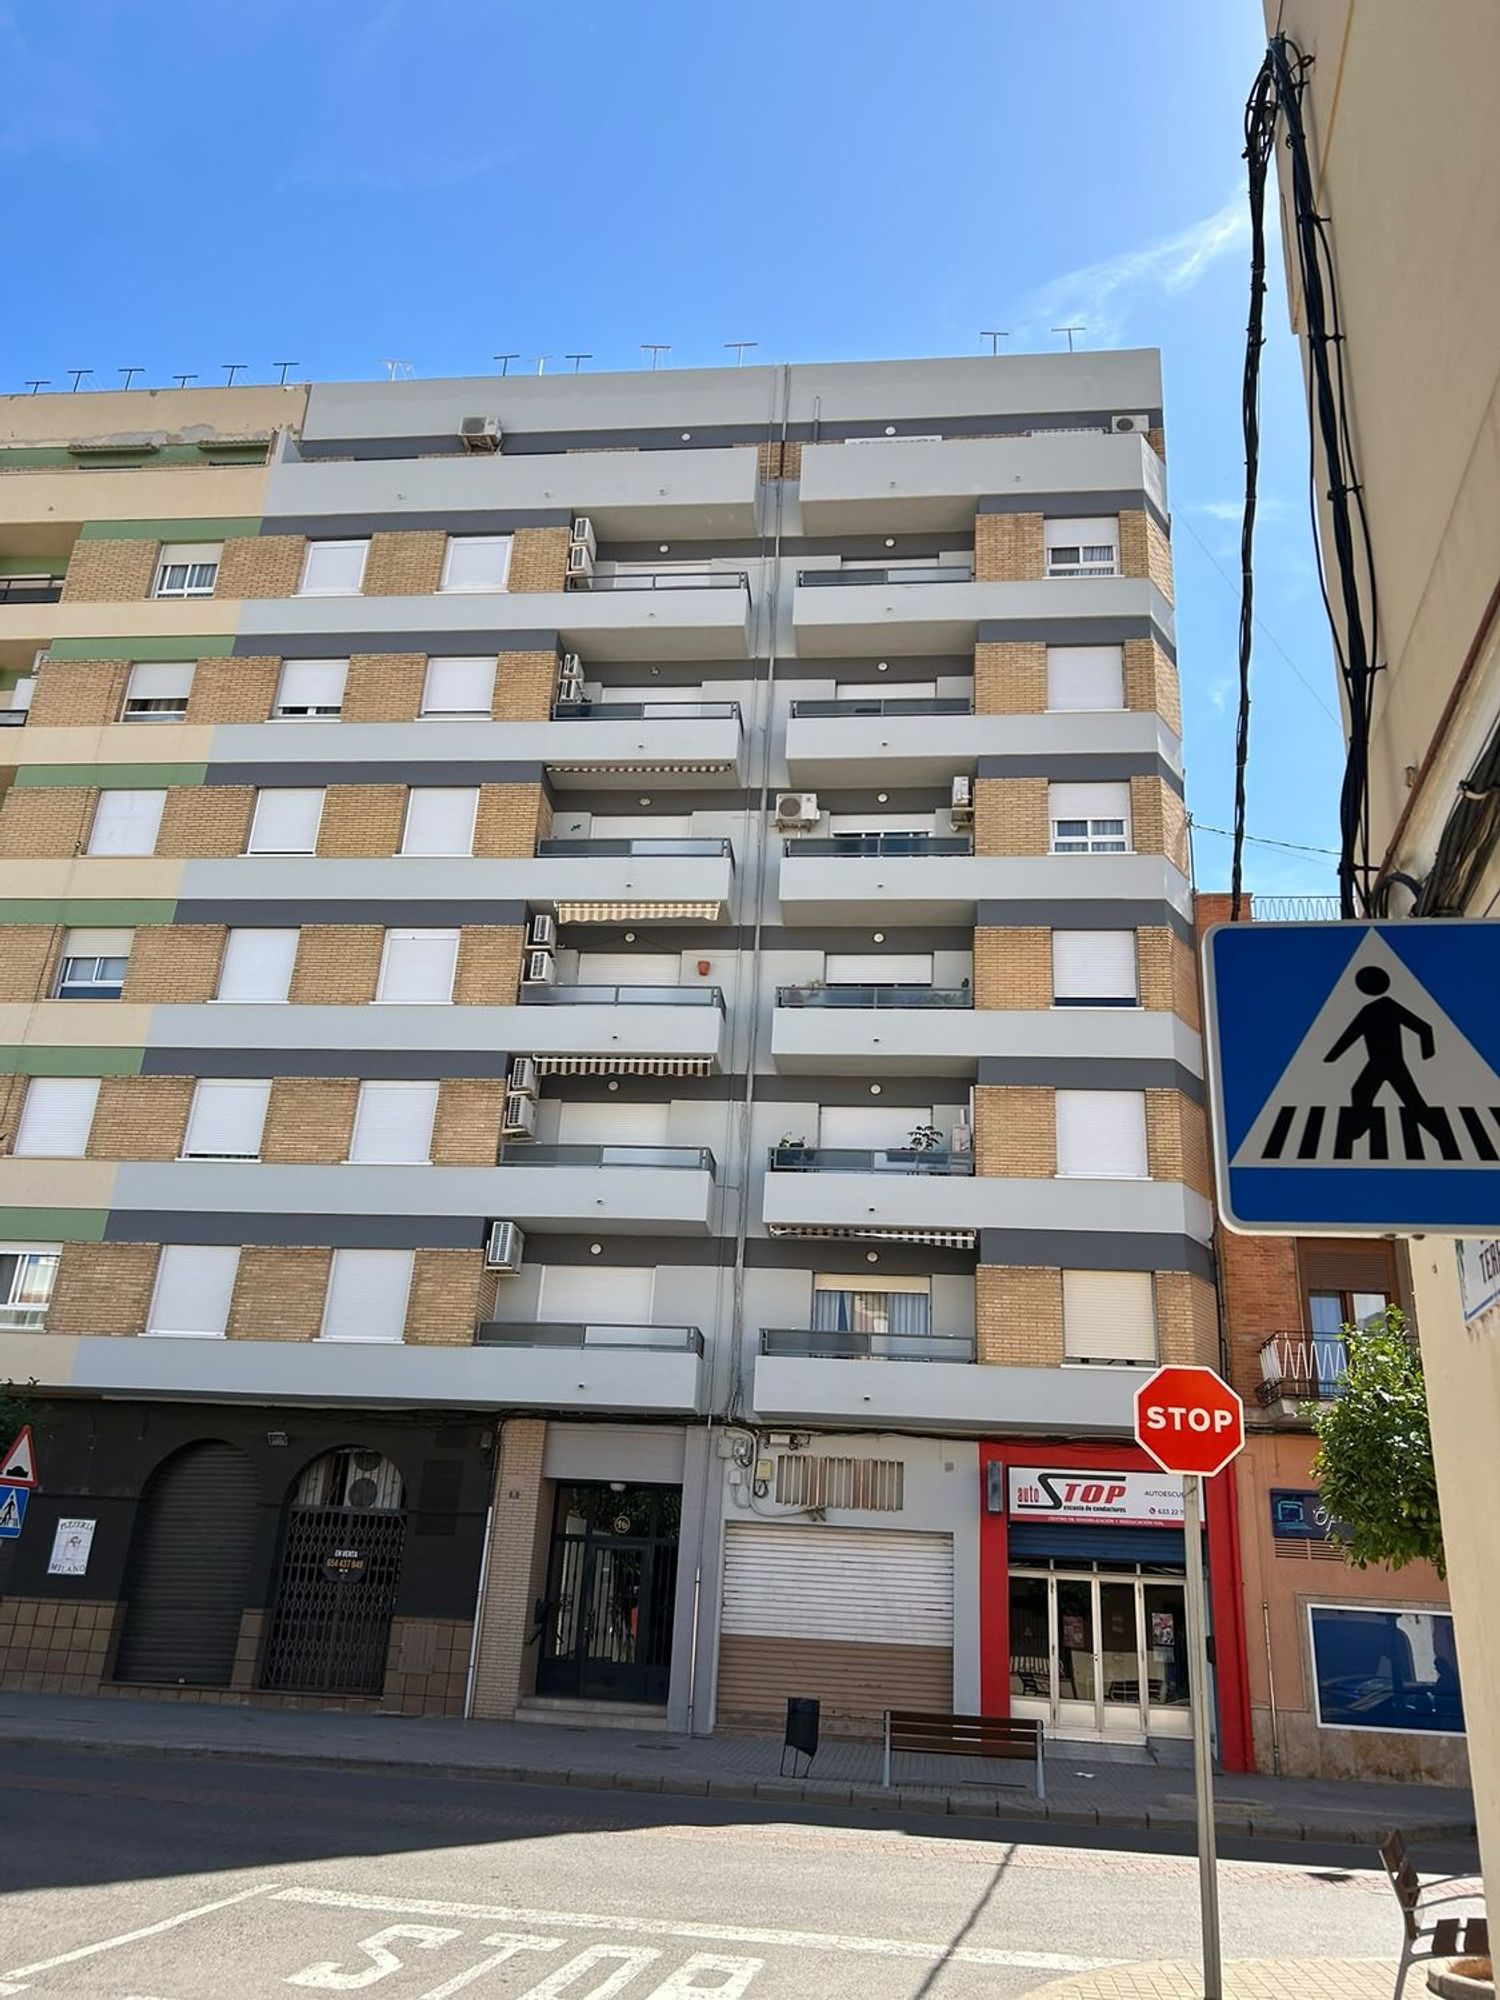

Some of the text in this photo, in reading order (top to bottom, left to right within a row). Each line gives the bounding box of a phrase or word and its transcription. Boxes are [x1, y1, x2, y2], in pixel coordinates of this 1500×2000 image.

[1146, 1405, 1233, 1433] STOP
[1144, 1489, 1185, 1498] AUTOESCU
[51, 1562, 86, 1572] MILANO
[282, 1924, 766, 2000] STOP
